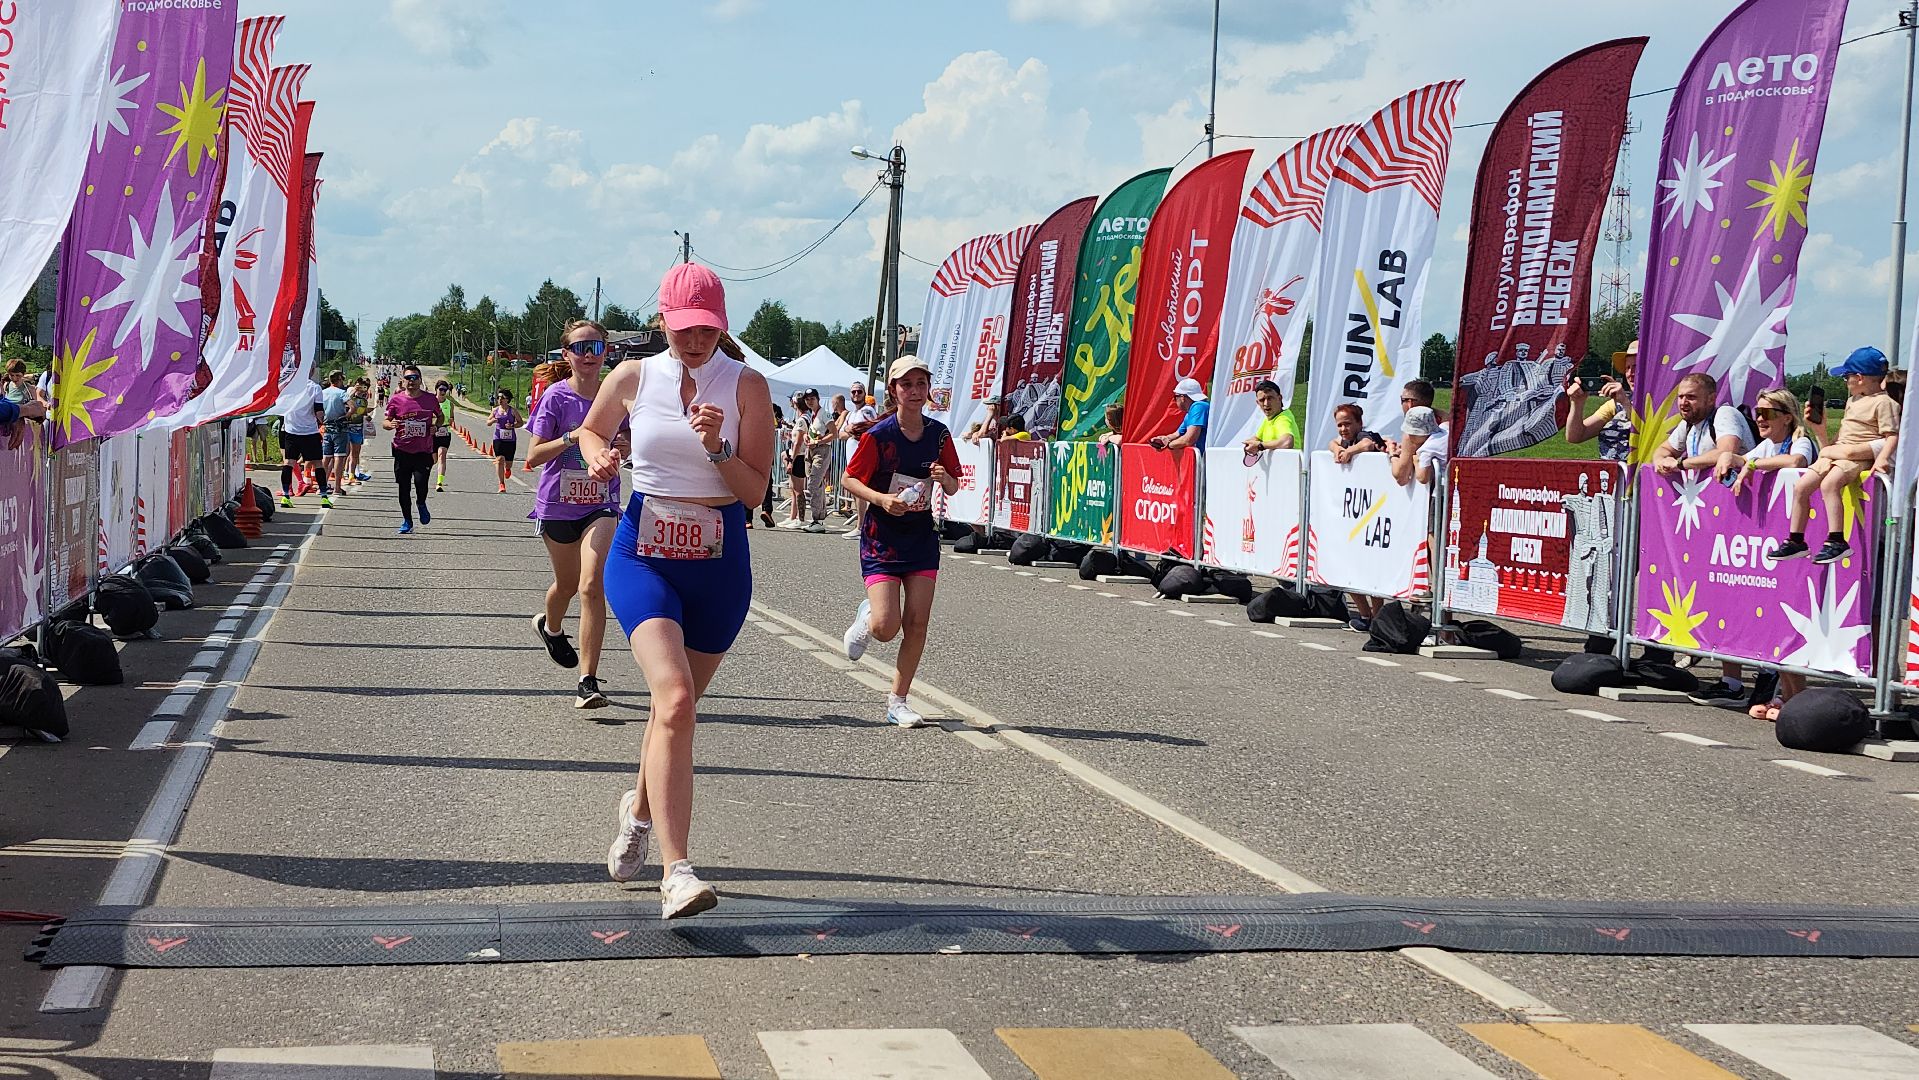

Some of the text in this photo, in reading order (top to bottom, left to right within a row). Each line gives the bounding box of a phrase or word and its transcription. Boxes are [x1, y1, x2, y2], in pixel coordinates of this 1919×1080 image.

[1717, 84, 1815, 104] подмосковье
[1102, 233, 1146, 241] подмосковь
[1511, 110, 1563, 327] ВОЛОКОЛАМСКИЙ
[1490, 168, 1522, 332] Полумарафон
[1377, 249, 1407, 329] LAB
[1540, 239, 1579, 325] РУБЕЖ
[1021, 273, 1038, 368] Полумарафон
[1158, 248, 1183, 361] Советский
[1174, 229, 1209, 384] СПОРТ
[971, 317, 993, 400] МОСОБЛ
[1043, 312, 1064, 363] РУБЕЖ
[1233, 341, 1263, 375] 80
[1343, 312, 1375, 399] RUN
[982, 335, 1001, 399] СПОРТ
[569, 481, 598, 497] 3160
[1343, 487, 1373, 519] RUN
[1498, 484, 1561, 506] Полумарафон
[1135, 498, 1177, 525] СПОРТ
[1365, 516, 1392, 549] LAB
[653, 519, 702, 548] 3188
[1511, 537, 1543, 565] РУБЕЖ
[1716, 572, 1778, 589] подмосковье
